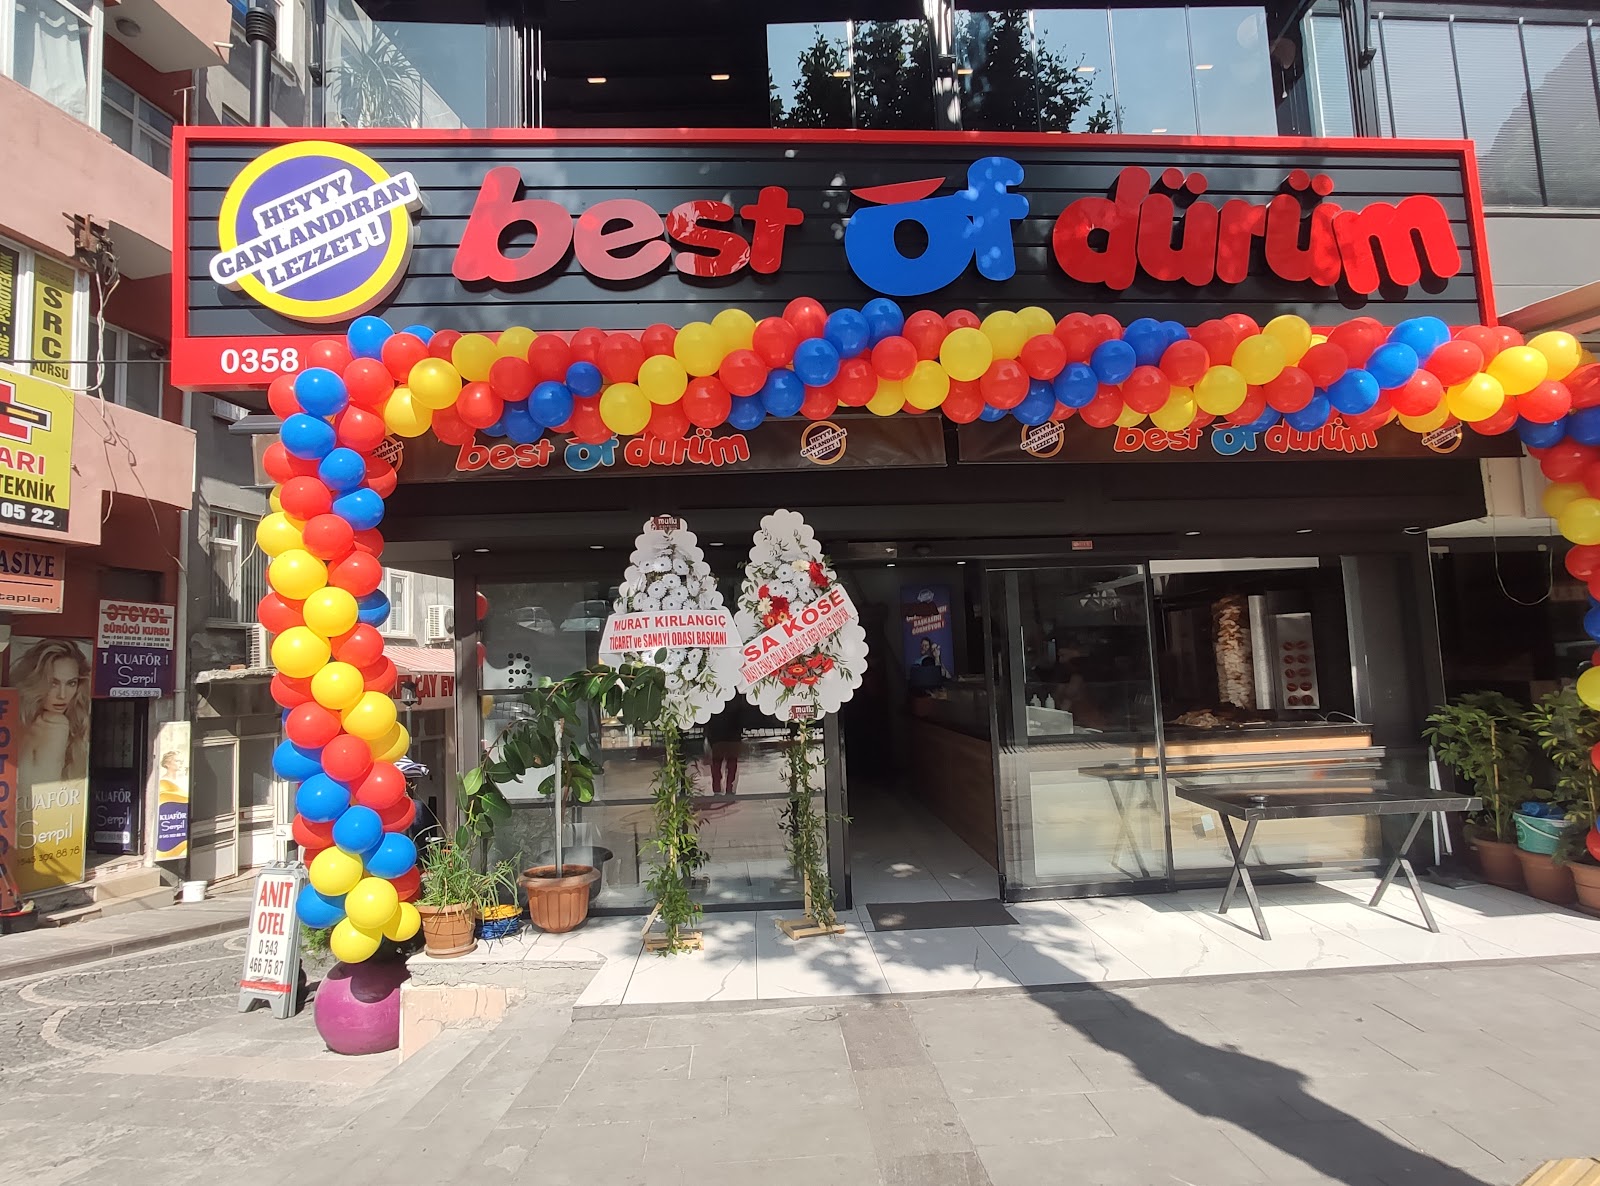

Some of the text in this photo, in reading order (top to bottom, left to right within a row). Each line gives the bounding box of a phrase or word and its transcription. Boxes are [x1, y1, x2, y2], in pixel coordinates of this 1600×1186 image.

[260, 175, 346, 230] HEYYY
[216, 178, 411, 278] CANLANDIRAN
[452, 156, 1461, 295] best of dürüm
[266, 228, 363, 286] LEZZET
[33, 359, 69, 380] KURSU
[220, 348, 299, 373] 0358
[801, 429, 846, 456] CANLANDIRAN
[1114, 426, 1203, 452] best
[0, 447, 44, 475] ARI
[455, 436, 555, 471] best
[1, 502, 55, 525] 05 22
[0, 549, 54, 577] ASİYE
[103, 622, 170, 635] SÜRÜCÜ KURSU
[614, 615, 726, 631] MURAT KIRLANGIÇ
[609, 630, 727, 650] TİCARET ve SANAYİ ODASI BAŞKANI
[742, 635, 780, 668] SA
[115, 653, 161, 666] KUAFÖR
[118, 665, 157, 686] Serpil
[19, 813, 73, 849] Serpil
[258, 881, 293, 908] ANIT
[257, 911, 285, 935] OTEL
[264, 940, 278, 955] 543
[249, 957, 284, 976] 466 75 87
